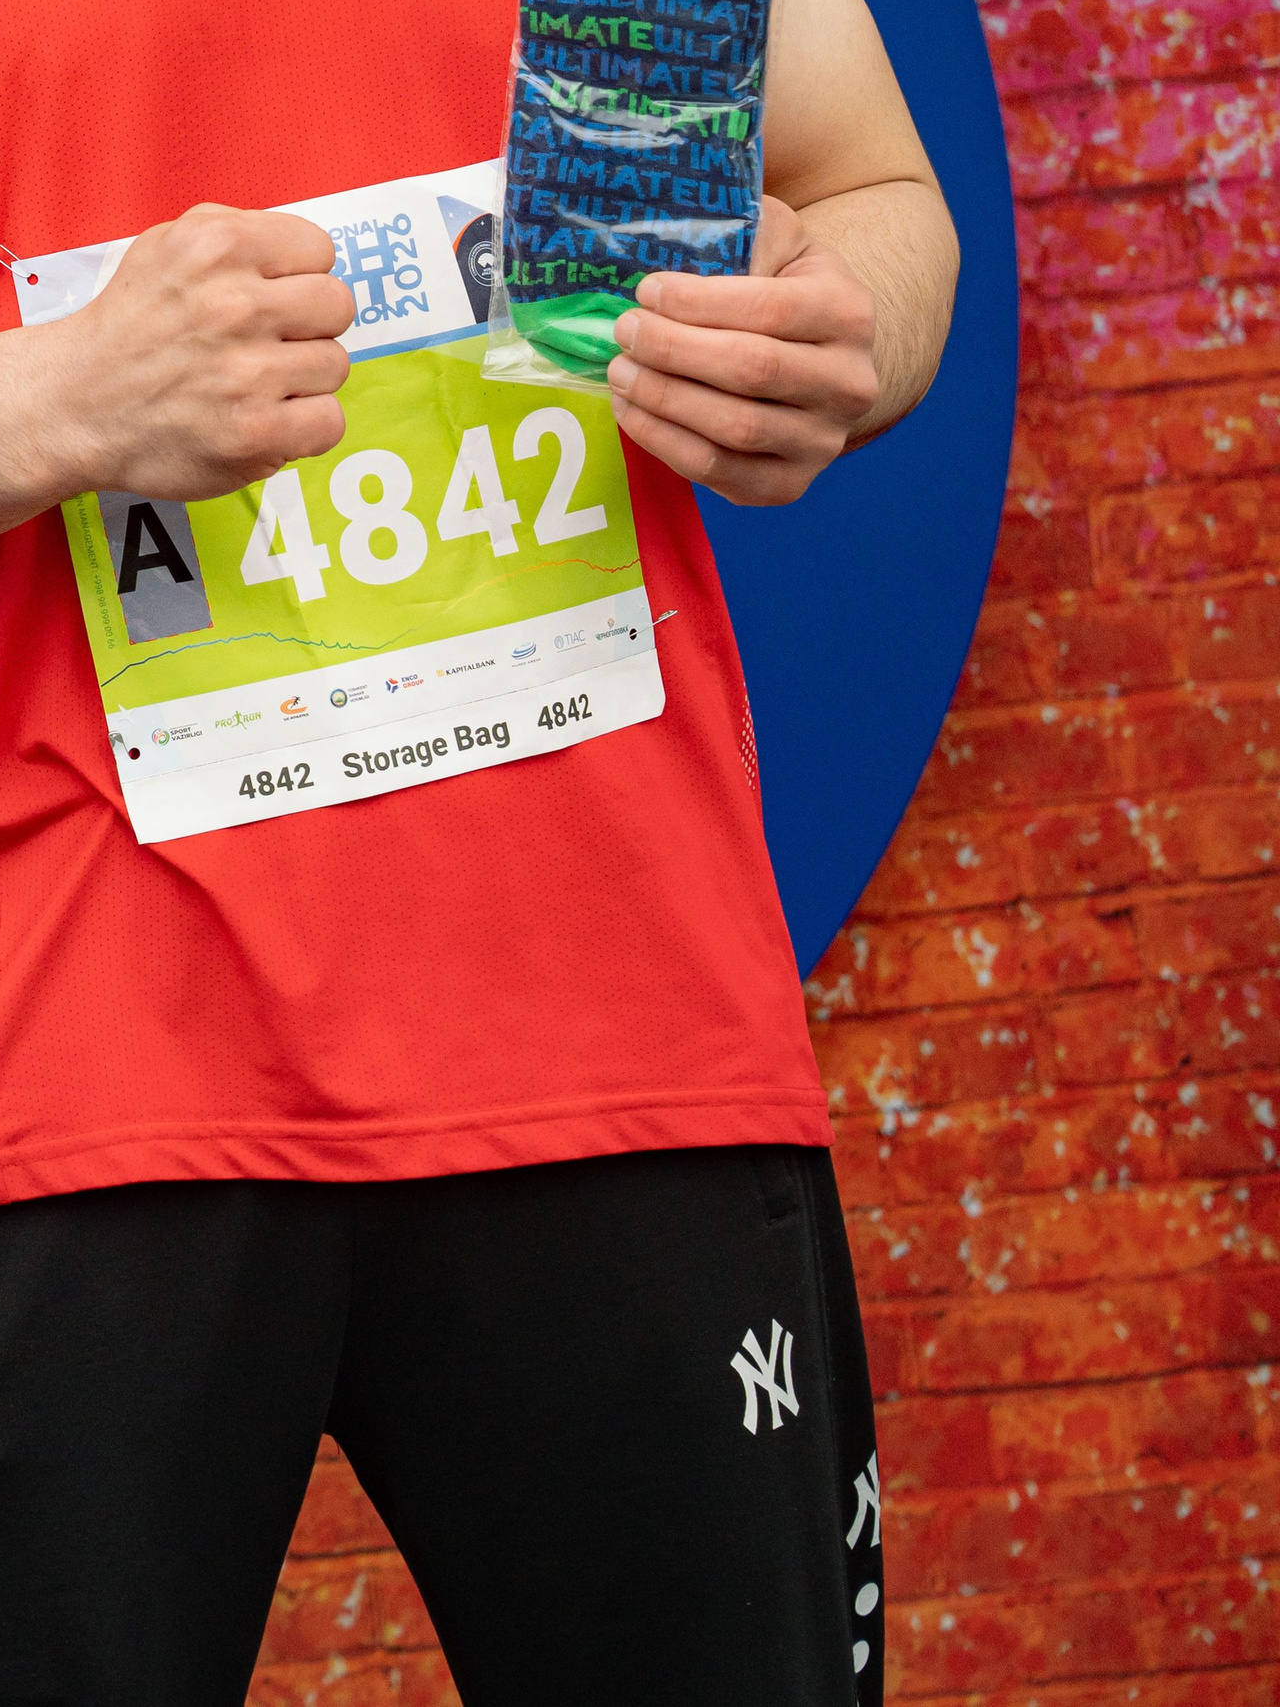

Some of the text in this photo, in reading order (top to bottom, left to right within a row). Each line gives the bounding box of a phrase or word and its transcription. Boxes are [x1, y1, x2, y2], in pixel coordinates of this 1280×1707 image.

[520, 6, 654, 51] IMATE
[239, 406, 609, 604] 4842
[117, 501, 194, 595] A
[565, 629, 587, 645] TIAC
[446, 659, 496, 676] KAPITALBANK
[401, 674, 419, 683] ENCO
[403, 679, 425, 689] GROUP
[214, 711, 262, 729] PRO RUN
[170, 726, 192, 736] SPORT
[171, 730, 203, 742] VAZIRLIGI
[238, 693, 593, 800] 4842 Storage Bag 4842
[730, 1318, 800, 1436] NY
